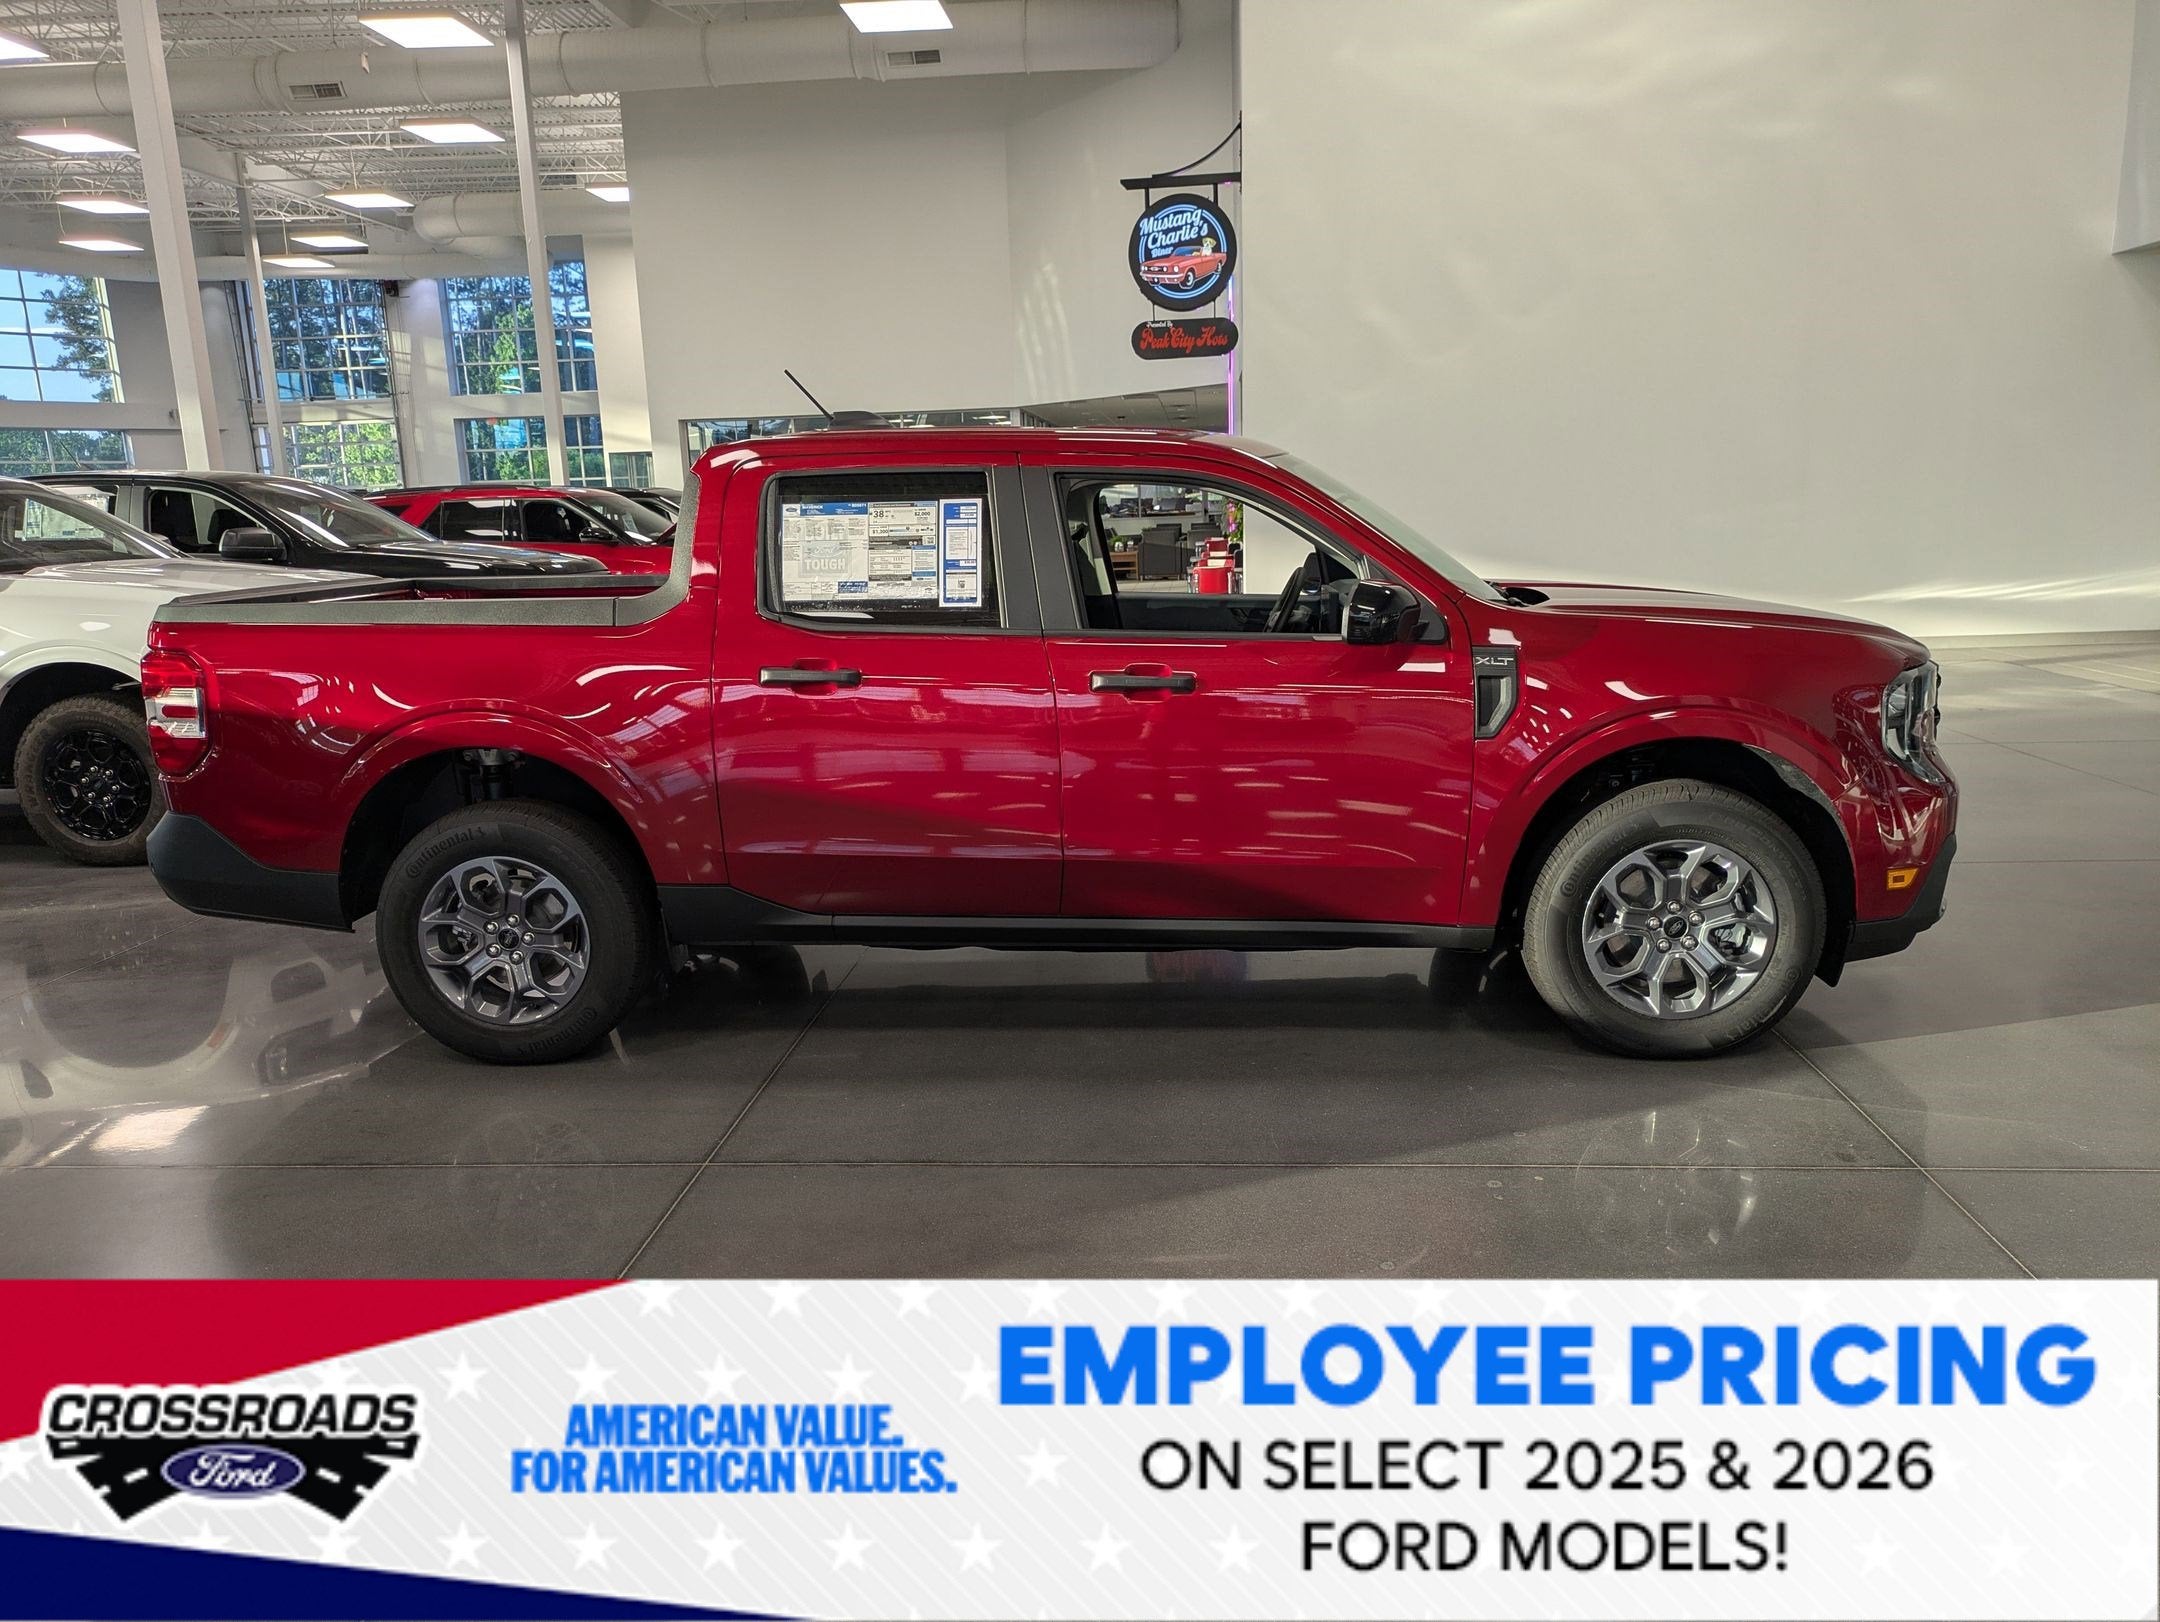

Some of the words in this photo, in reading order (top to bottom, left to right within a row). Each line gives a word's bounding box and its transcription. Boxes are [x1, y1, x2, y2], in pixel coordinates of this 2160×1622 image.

[1140, 209, 1202, 236] Mustang
[1147, 222, 1209, 249] Charlie's
[1151, 247, 1174, 258] Diner
[1140, 328, 1170, 350] Peak
[1170, 327, 1195, 353] City
[804, 559, 845, 570] TOUGH
[1475, 656, 1514, 666] XLT
[406, 828, 474, 878] Continental
